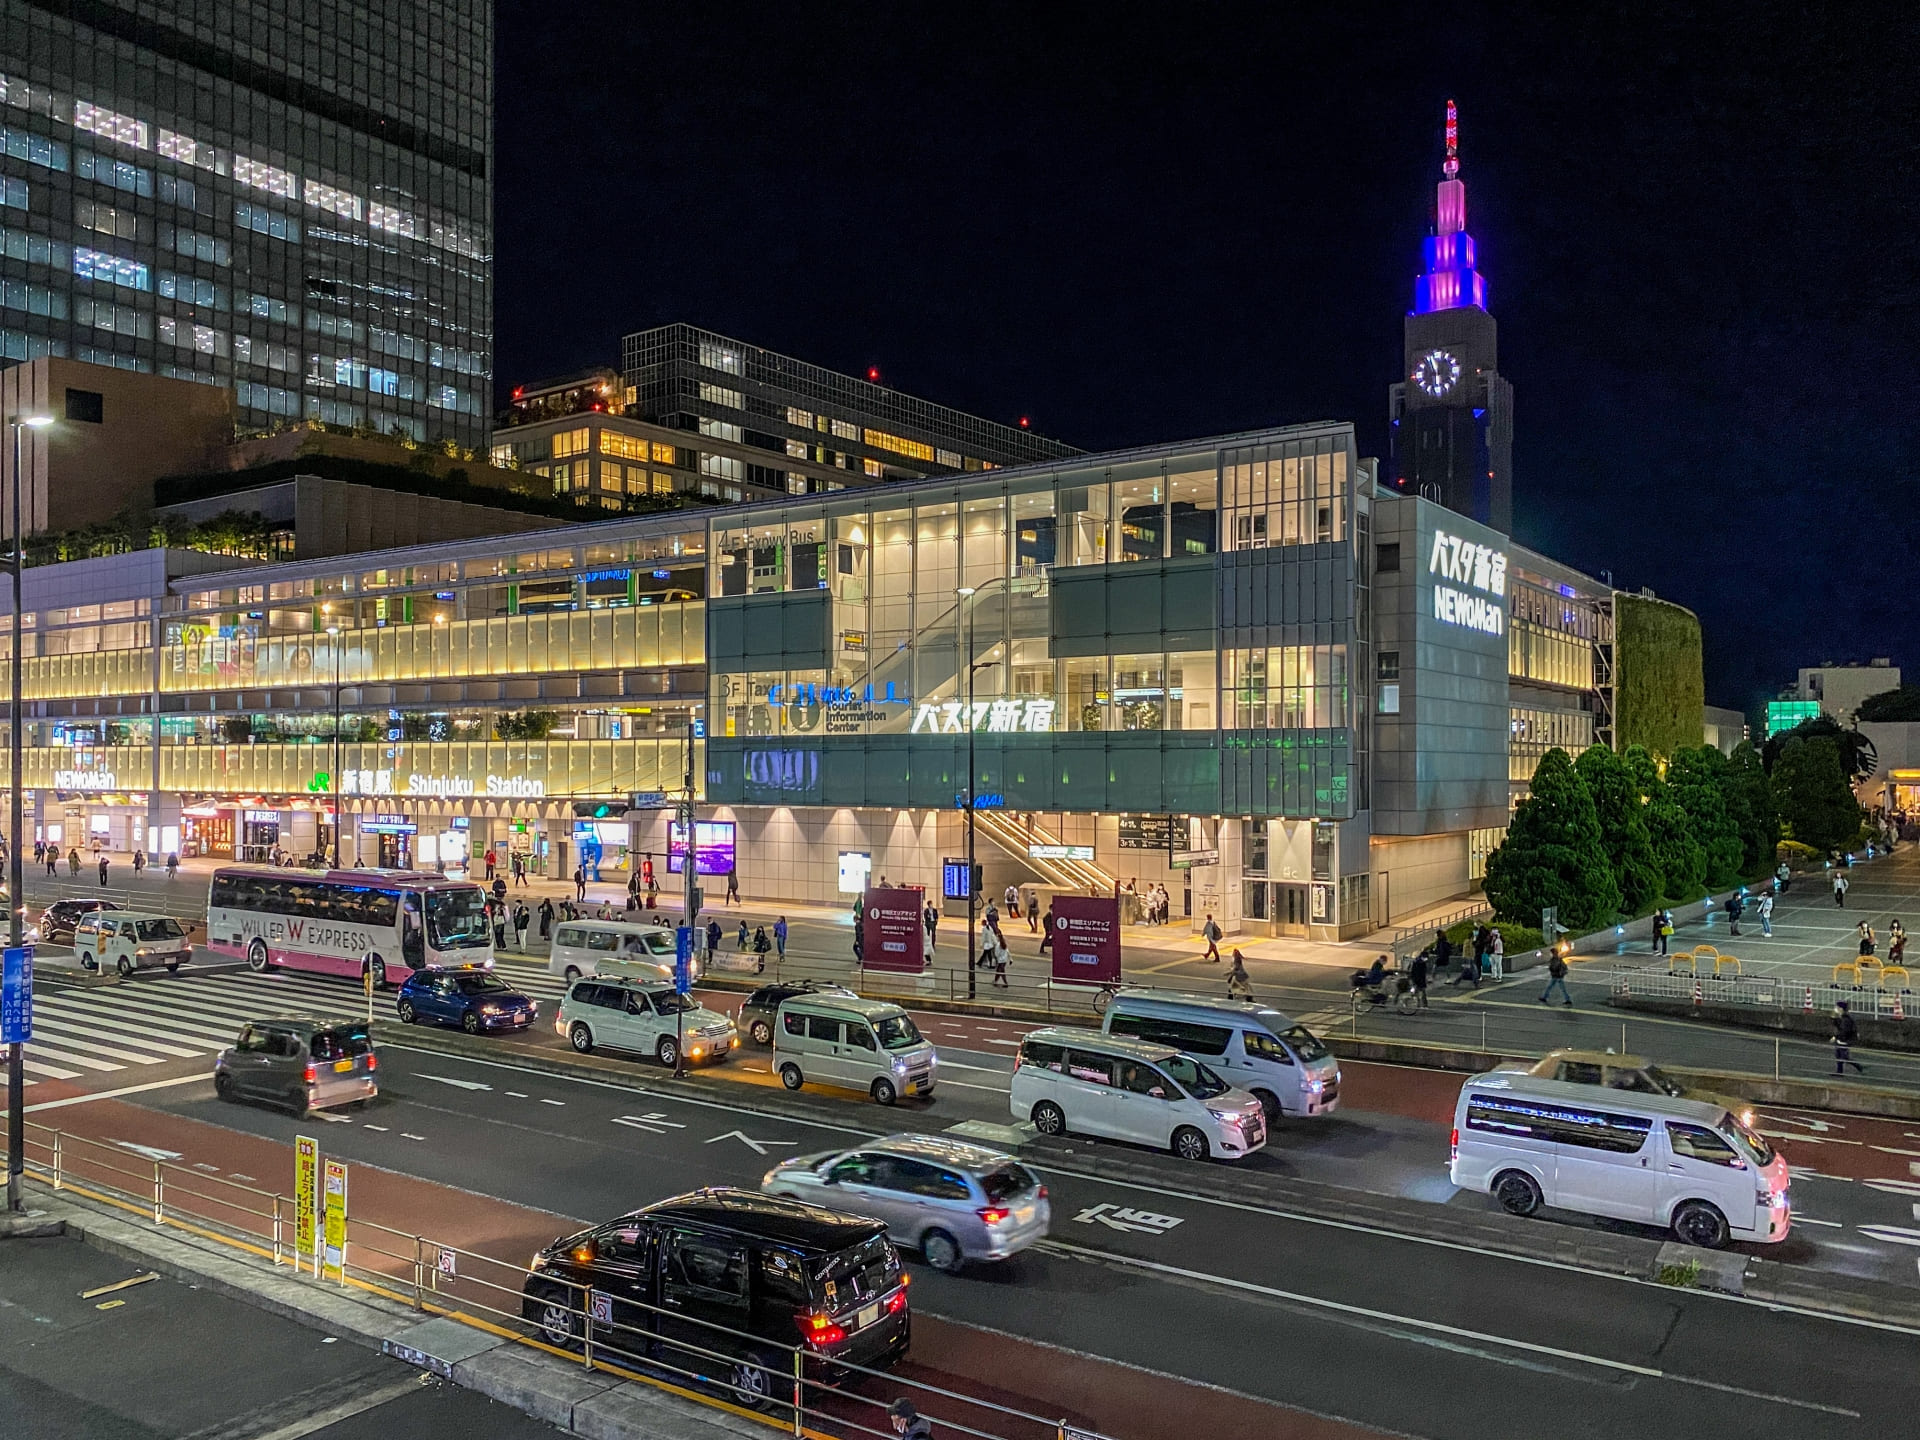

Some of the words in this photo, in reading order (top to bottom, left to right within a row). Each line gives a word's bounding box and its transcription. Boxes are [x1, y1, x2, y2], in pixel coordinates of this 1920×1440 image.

[747, 533, 787, 550] Expwy
[789, 530, 814, 546] Bus
[1429, 530, 1508, 596] バスタ新宿
[747, 681, 776, 698] Taxi
[826, 700, 863, 712] Tourist
[826, 710, 887, 723] Information
[911, 699, 1056, 734] バスタ新宿
[826, 721, 861, 733] Center
[307, 771, 330, 792] JR
[342, 769, 393, 796] 新宿駅
[408, 773, 474, 799] Shinjuku
[486, 774, 545, 798] Station
[240, 917, 285, 941] WILLER
[308, 927, 367, 951] EXPRESS
[301, 1159, 310, 1241] 路上ライブ禁止
